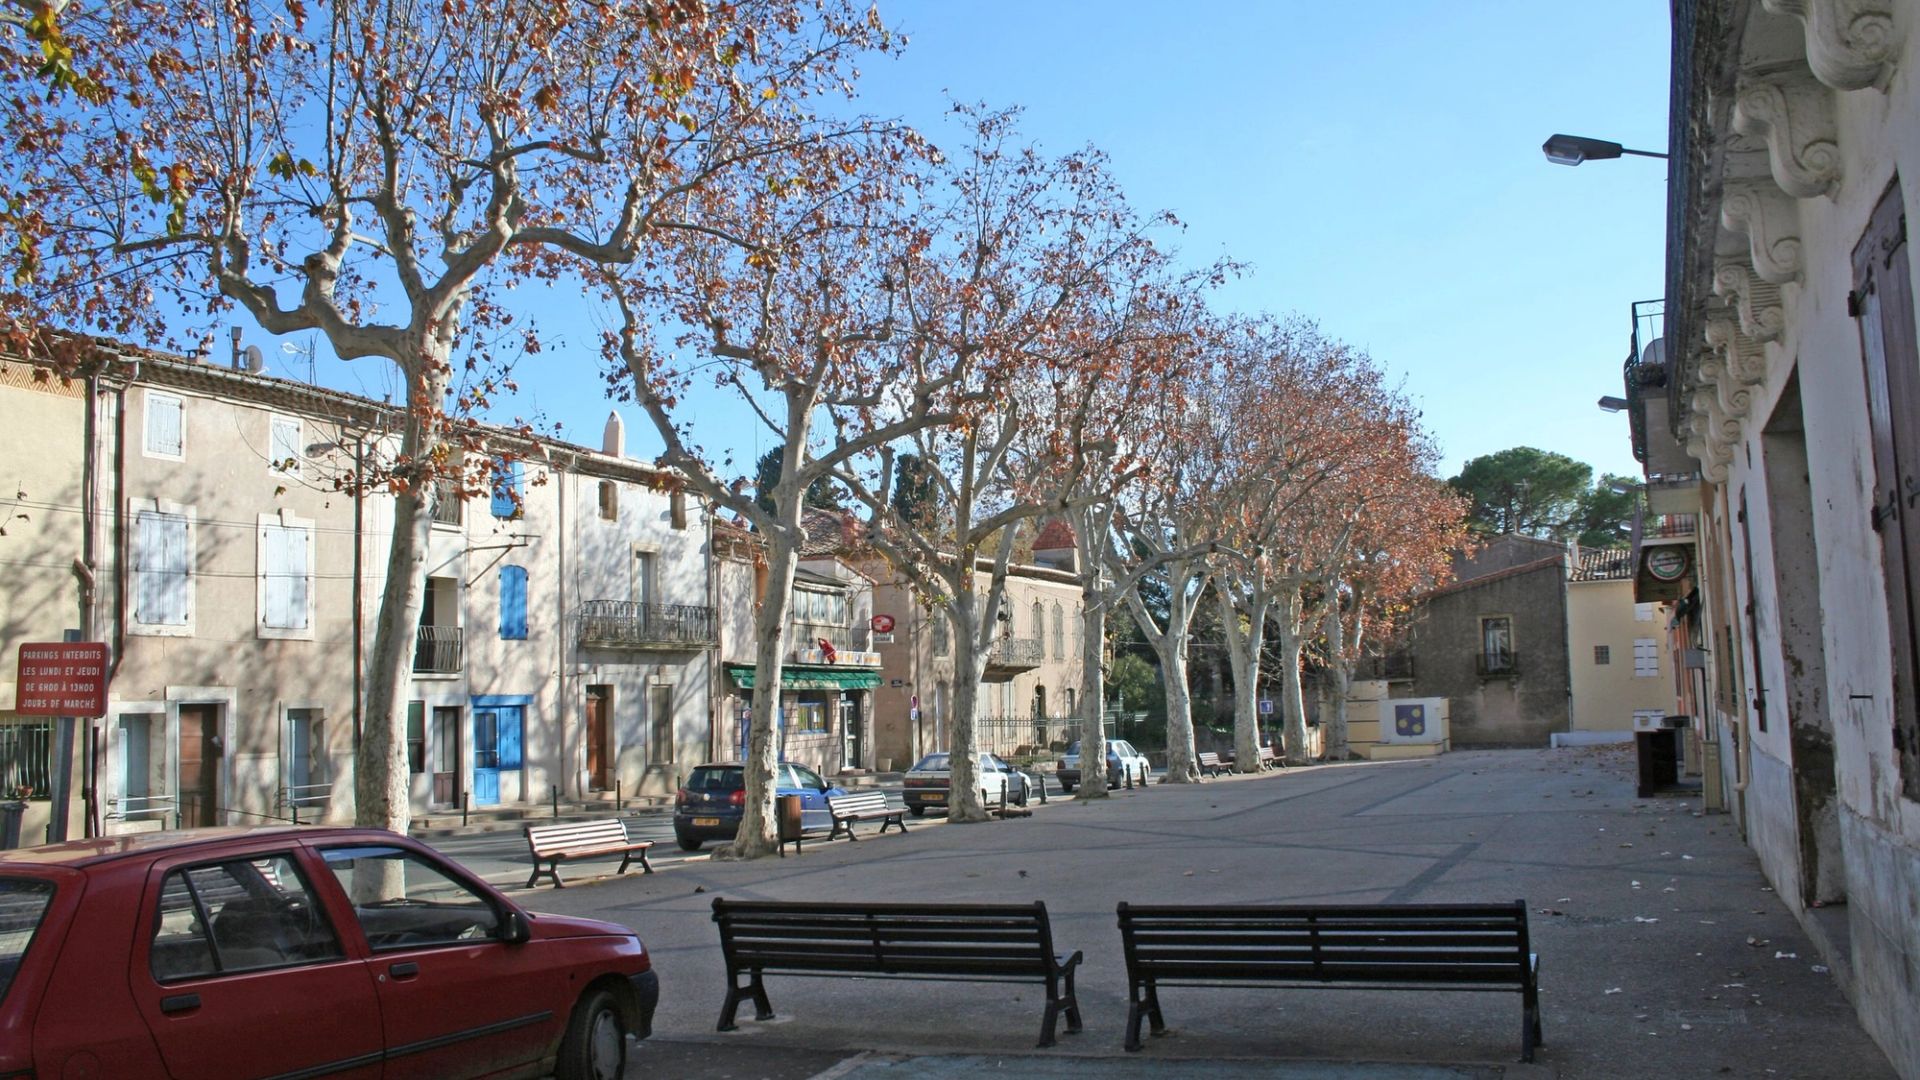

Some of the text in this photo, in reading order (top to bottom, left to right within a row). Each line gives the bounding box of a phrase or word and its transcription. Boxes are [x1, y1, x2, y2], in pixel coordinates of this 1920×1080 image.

[23, 650, 102, 659] PARKINGS INTERDITS
[22, 667, 100, 676] LES LUNDI ET JEUDI
[25, 683, 34, 692] DE
[22, 699, 46, 708] JOURS
[64, 698, 96, 708] MARCHÉ
